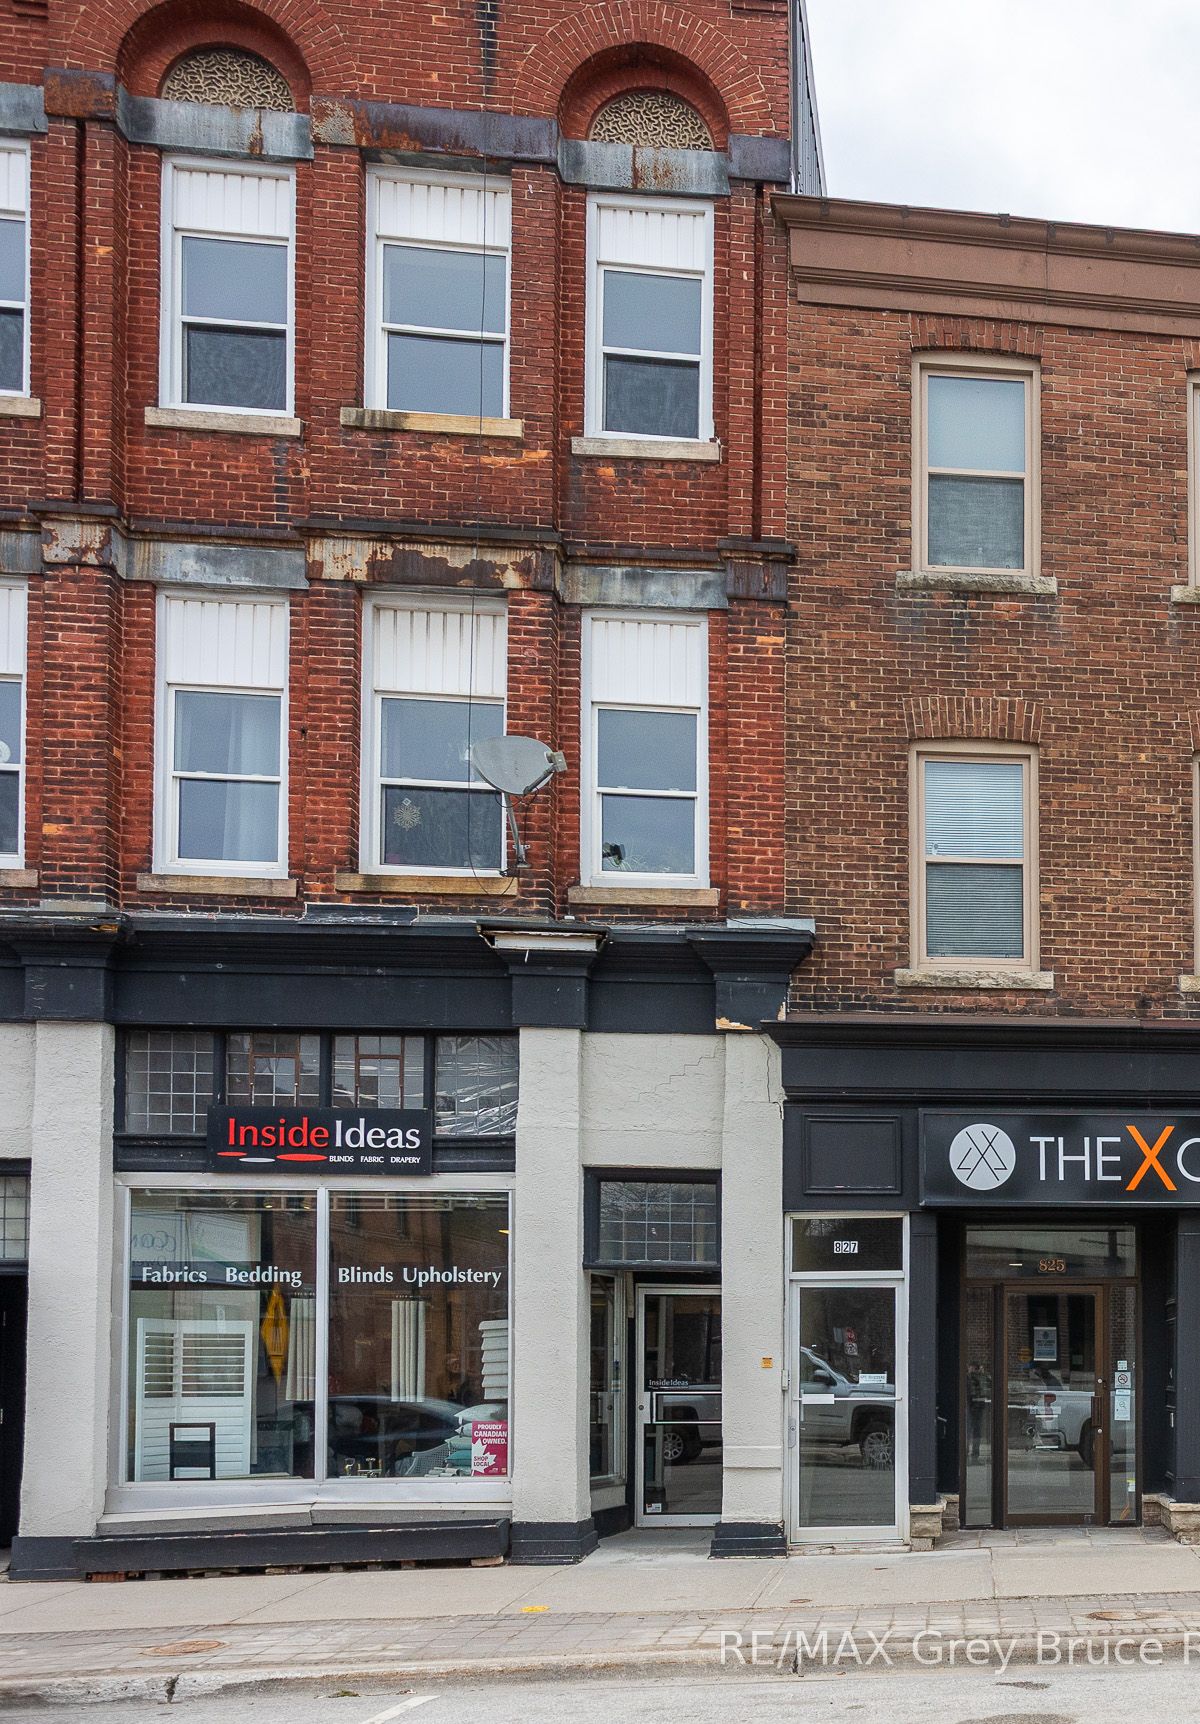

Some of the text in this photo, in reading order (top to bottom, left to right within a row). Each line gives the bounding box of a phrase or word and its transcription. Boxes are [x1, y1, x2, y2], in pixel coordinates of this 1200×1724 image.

[329, 1155, 421, 1164] BLINDS FABRIC DRAPERY
[834, 1241, 858, 1253] 827
[1039, 1259, 1065, 1272] 825
[142, 1265, 302, 1288] Fabrics Bedding
[338, 1266, 501, 1288] Blinds Upholstery
[474, 1430, 508, 1438] CANADIAN
